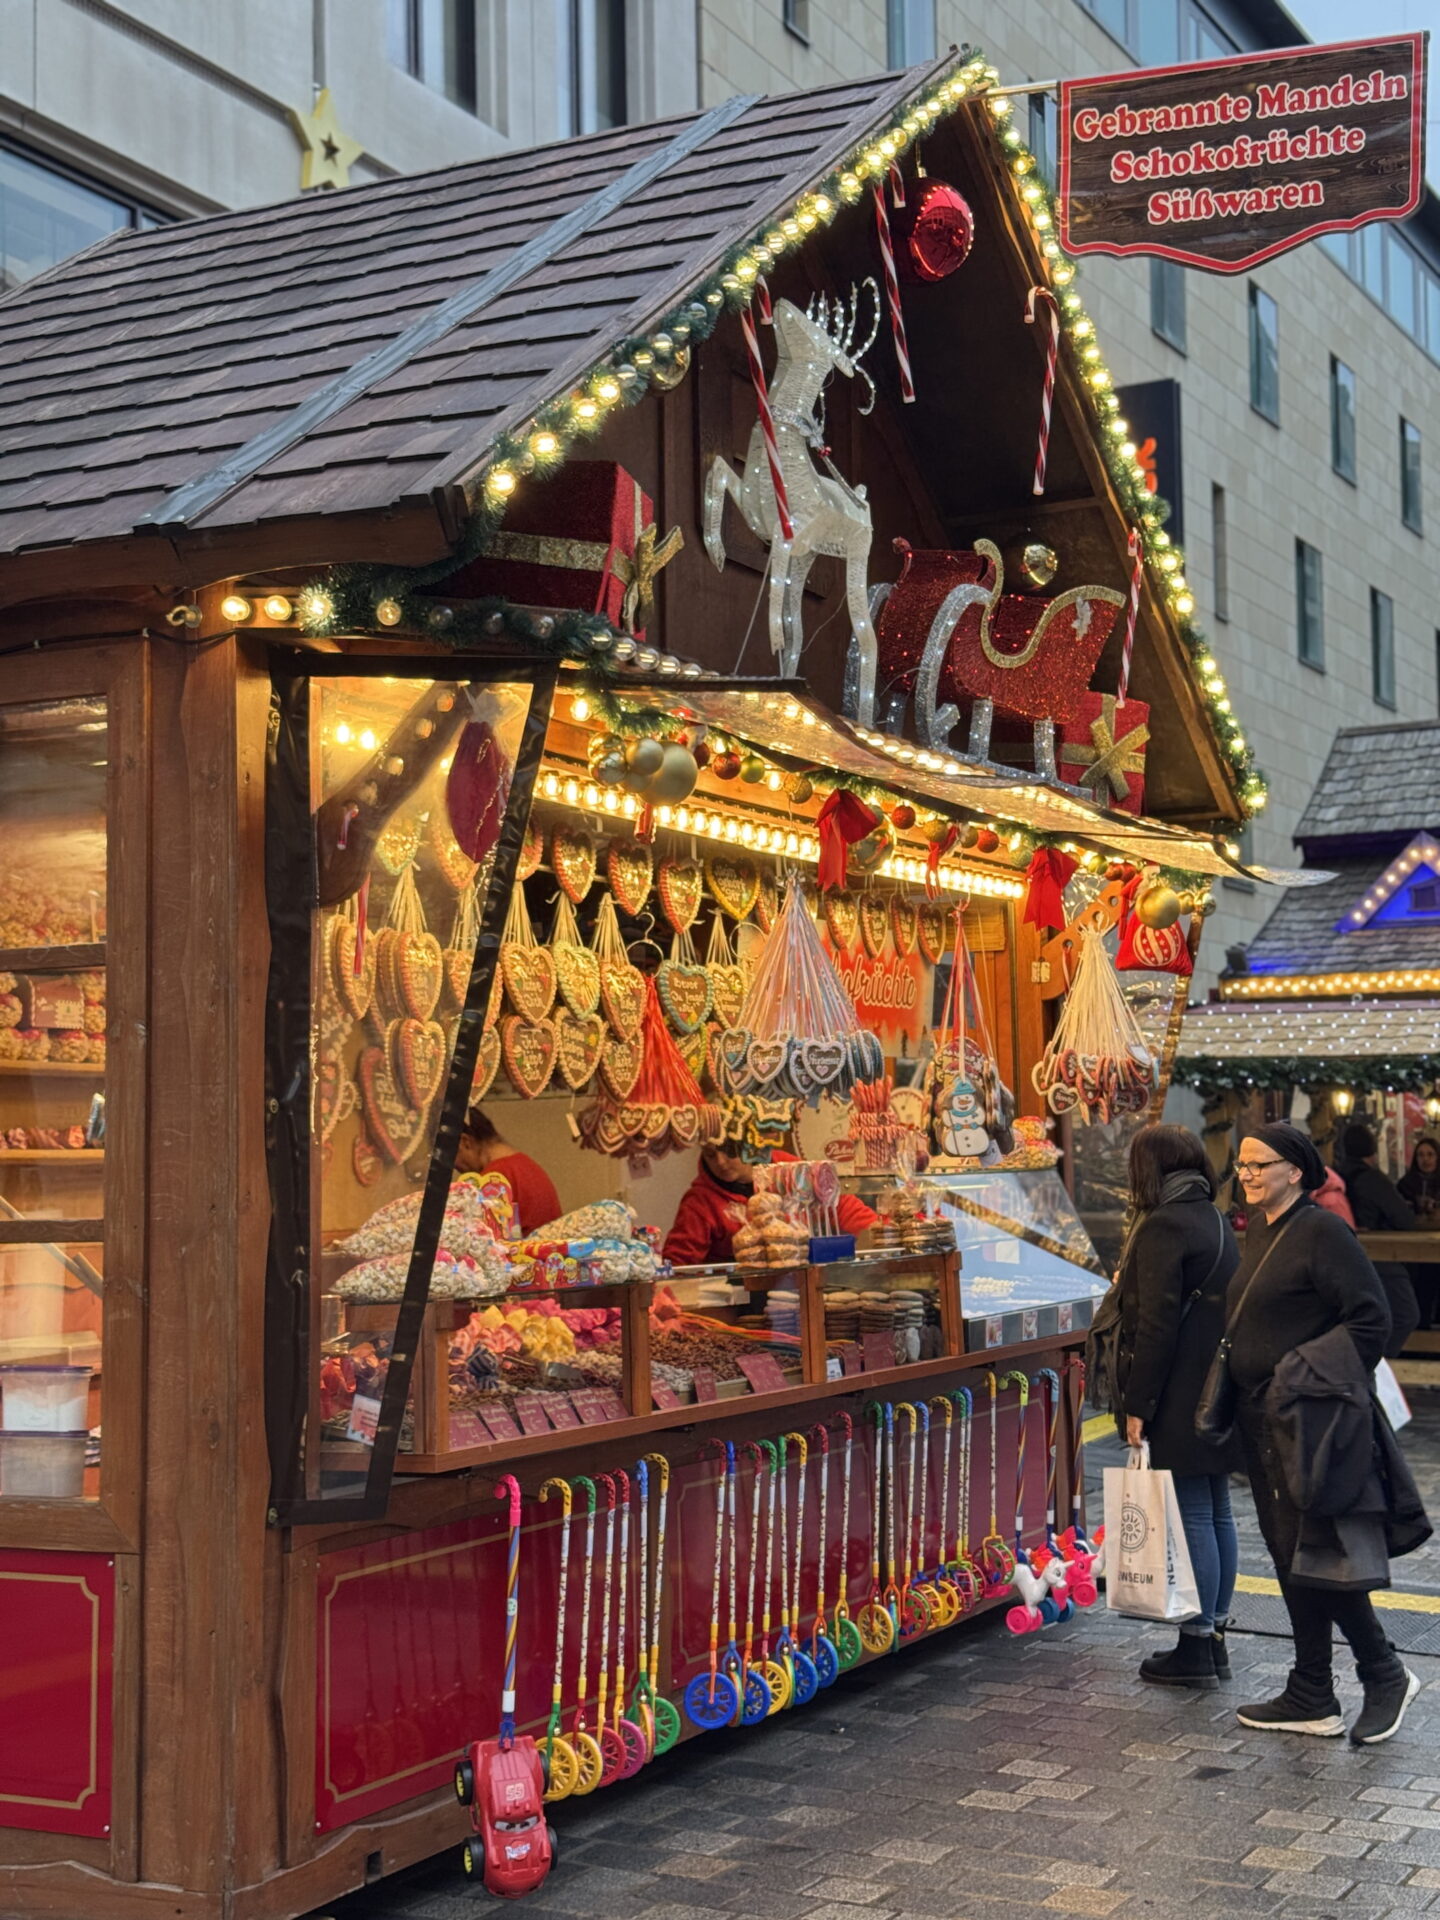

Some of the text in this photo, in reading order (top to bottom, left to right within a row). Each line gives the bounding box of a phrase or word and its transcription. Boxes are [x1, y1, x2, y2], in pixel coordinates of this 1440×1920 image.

[1074, 70, 1406, 141] Gebrannte Mandeln
[1111, 126, 1365, 183] Schokofrüchte
[1148, 181, 1323, 225] Süßwaren
[1118, 1571, 1154, 1584] WSEUM
